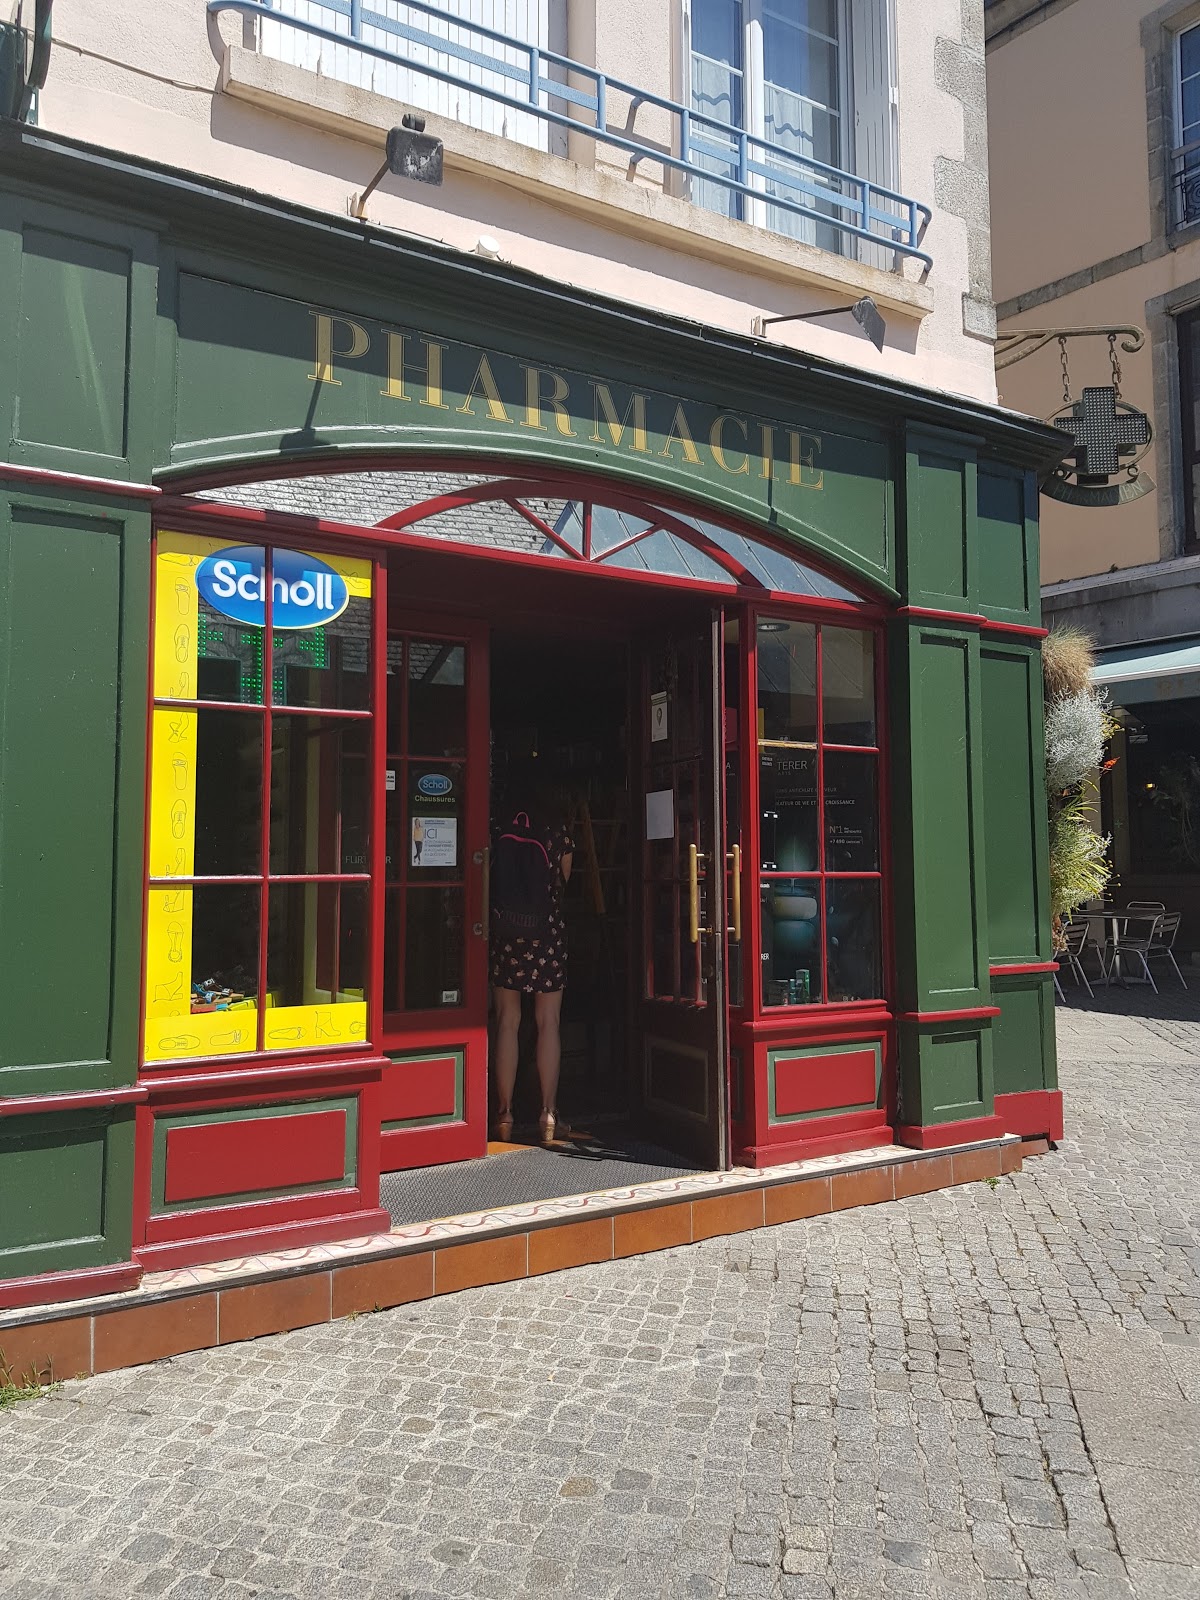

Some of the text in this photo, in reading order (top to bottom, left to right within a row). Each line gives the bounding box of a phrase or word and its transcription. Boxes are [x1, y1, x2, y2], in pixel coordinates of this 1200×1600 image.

[306, 310, 825, 491] PHARMACIE
[212, 559, 334, 611] Scholl
[422, 779, 448, 790] Scholl
[414, 794, 456, 803] Chaussures
[424, 828, 438, 839] ICI
